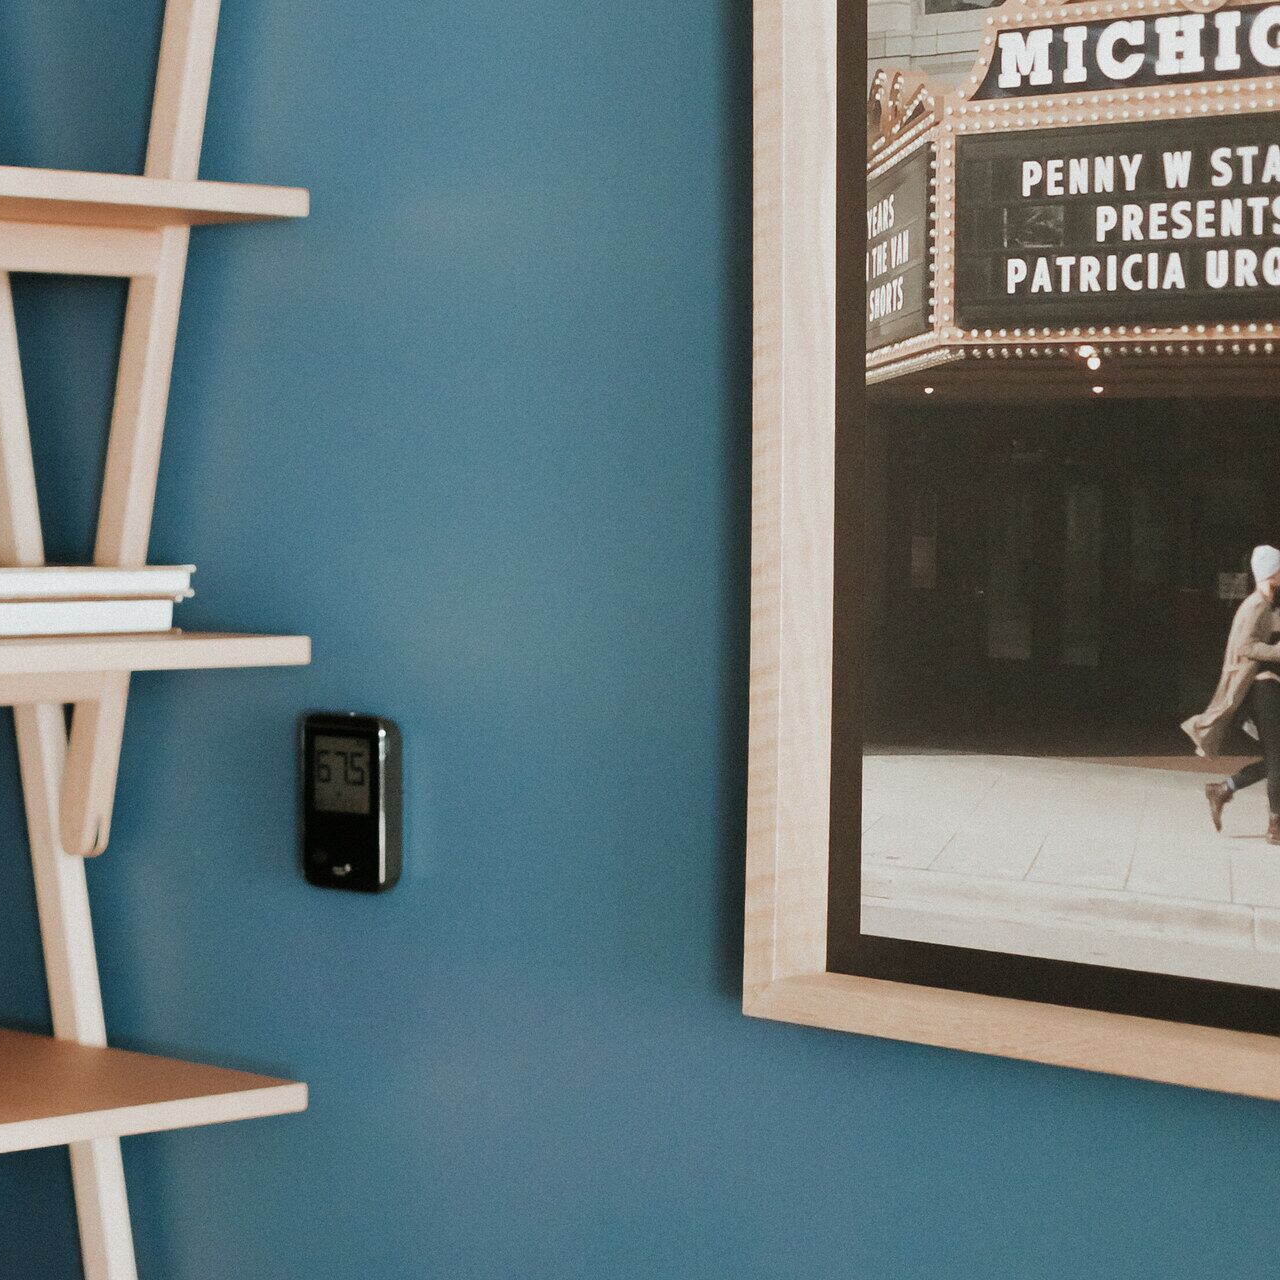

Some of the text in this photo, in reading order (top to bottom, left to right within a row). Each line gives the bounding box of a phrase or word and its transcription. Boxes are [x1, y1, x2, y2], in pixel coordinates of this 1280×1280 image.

[1022, 144, 1280, 197] PENNY W STA
[867, 193, 895, 240] YEARS
[872, 241, 888, 279] THE
[891, 229, 909, 269] VAN
[1007, 252, 1186, 294] PATRICIA
[869, 275, 904, 322] SHORTS
